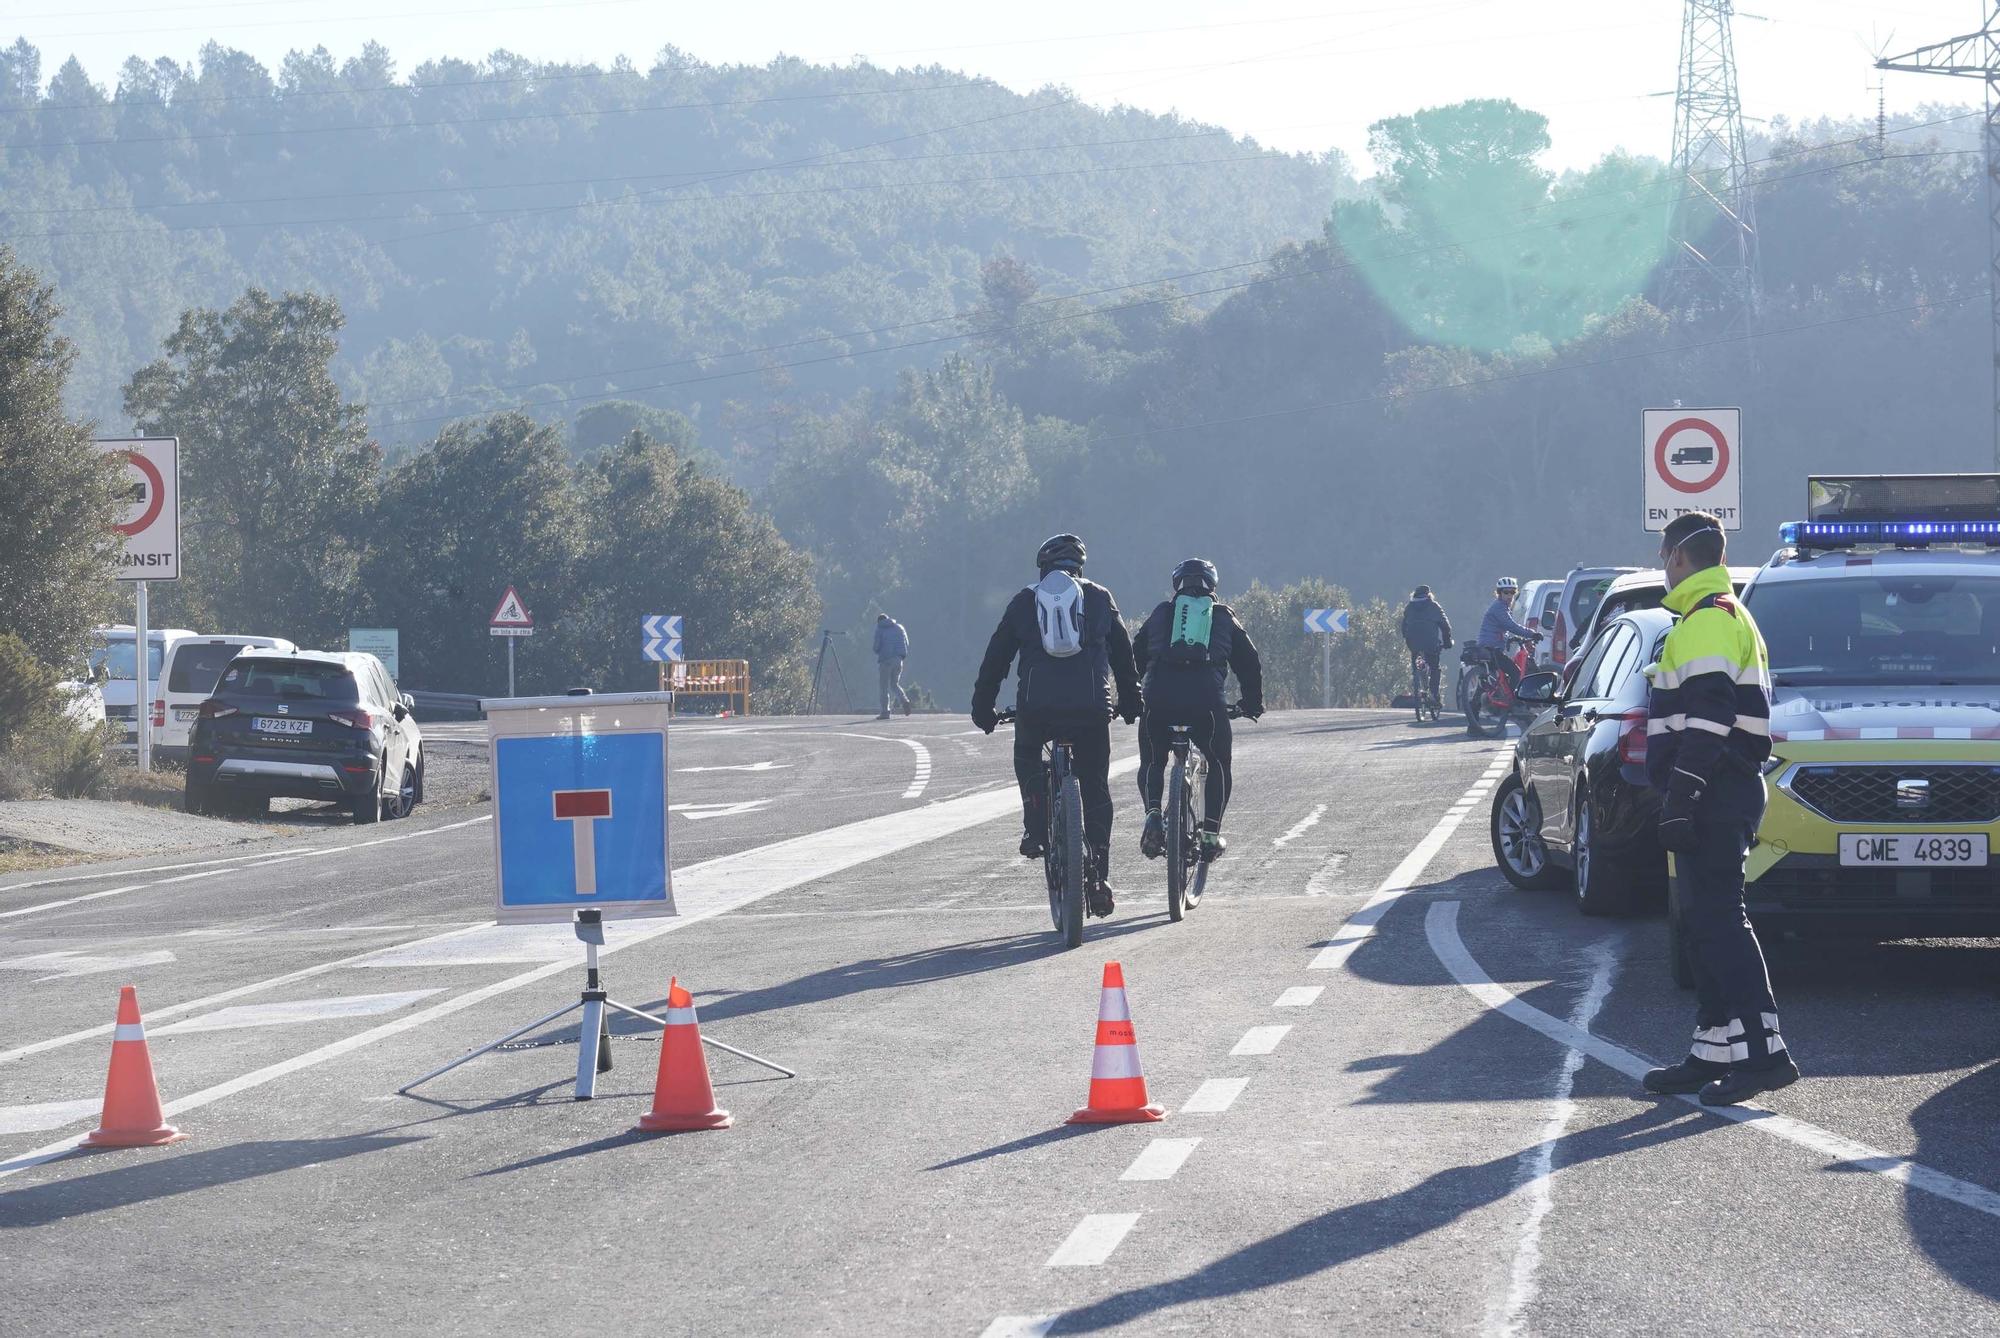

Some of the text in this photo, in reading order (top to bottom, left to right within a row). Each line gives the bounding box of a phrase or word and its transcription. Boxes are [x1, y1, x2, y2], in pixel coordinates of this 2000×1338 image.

[1649, 508, 1668, 520] EN
[260, 720, 309, 731] 6729 KZF
[1856, 838, 1972, 861] CME 4839
